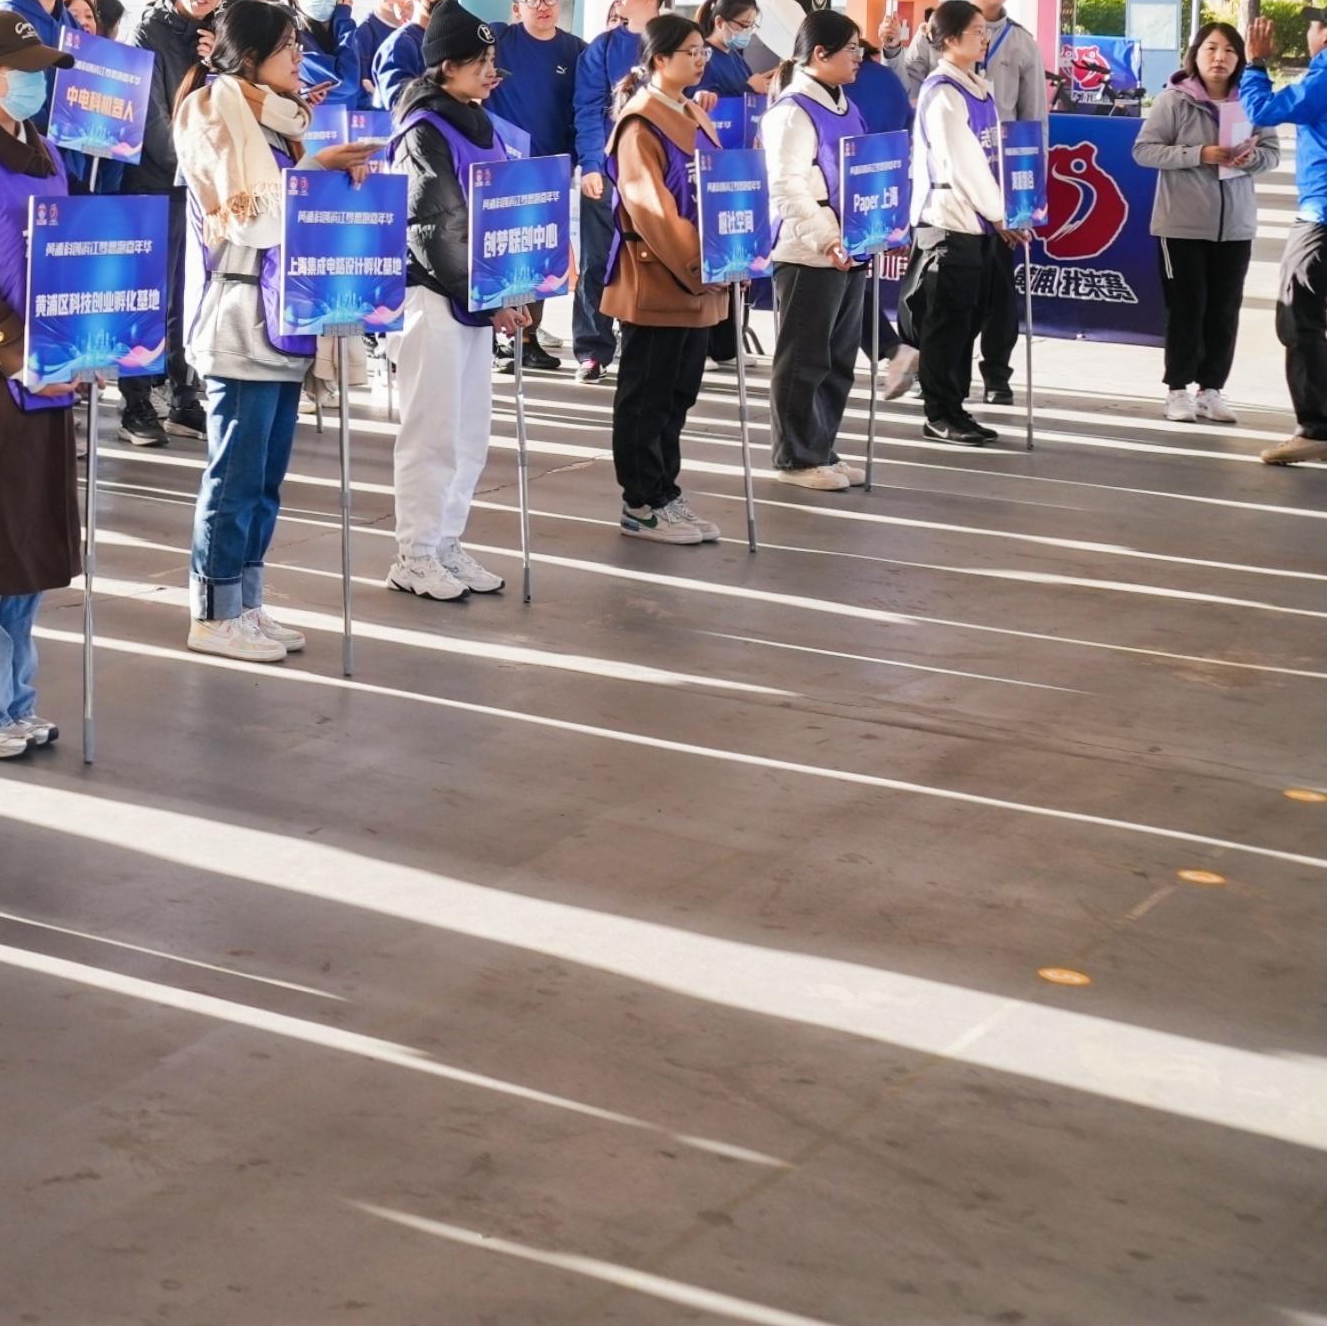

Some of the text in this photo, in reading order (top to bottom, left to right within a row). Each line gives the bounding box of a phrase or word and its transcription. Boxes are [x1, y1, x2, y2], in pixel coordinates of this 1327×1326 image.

[854, 194, 879, 215] Paper
[35, 289, 161, 318] 黄浦区科技创业孵化基地
